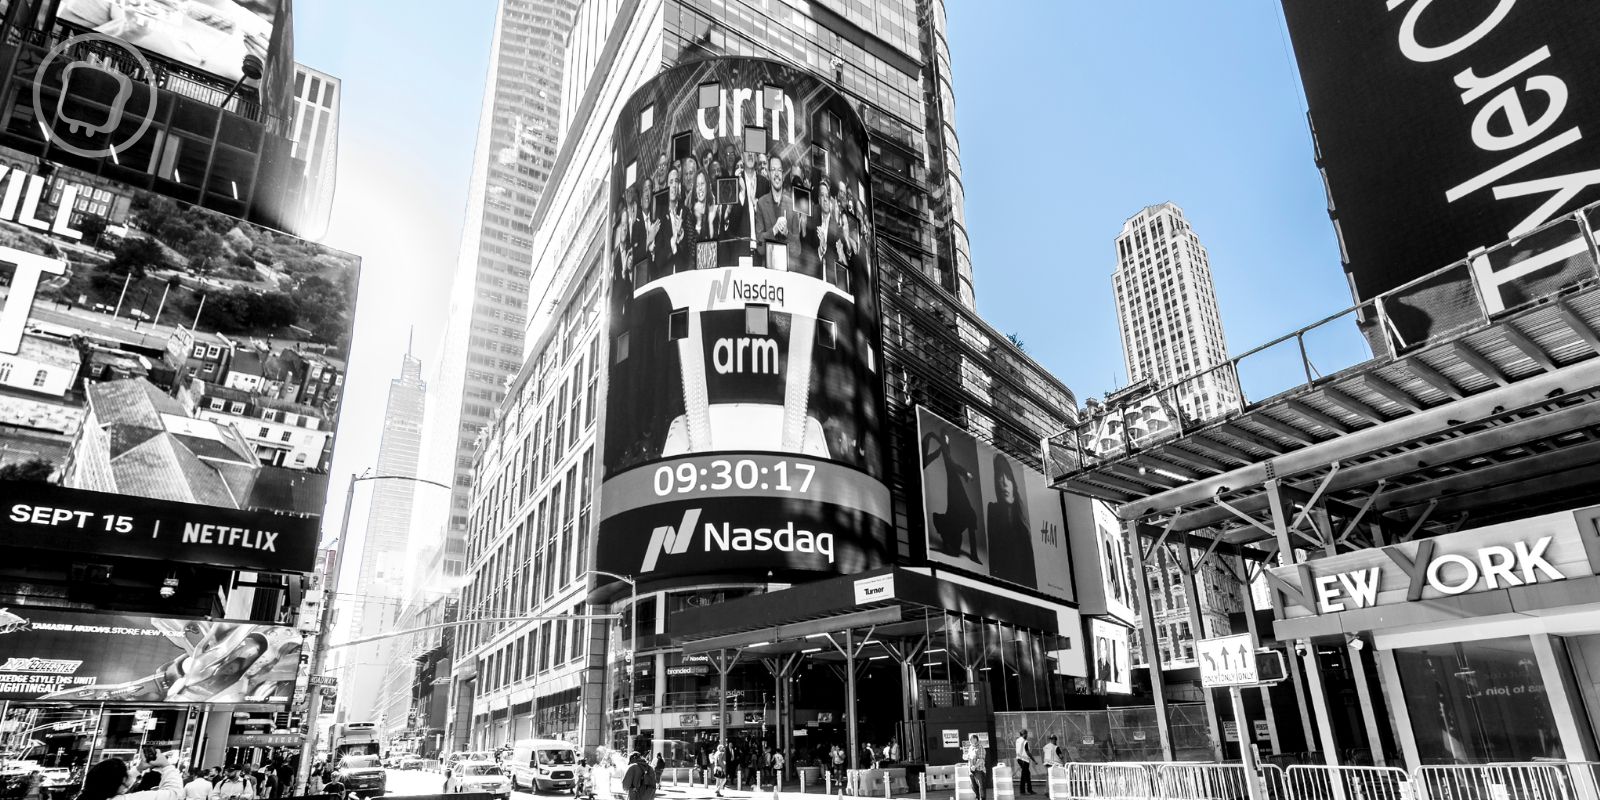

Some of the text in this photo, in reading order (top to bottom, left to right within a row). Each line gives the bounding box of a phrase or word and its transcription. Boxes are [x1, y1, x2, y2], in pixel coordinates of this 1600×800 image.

[697, 88, 795, 144] arm
[1446, 45, 1600, 316] Tyler
[0, 164, 83, 239] ILL
[733, 280, 784, 307] Nasdaq
[713, 337, 779, 374] arm
[654, 460, 816, 496] 09:30:17
[9, 503, 279, 552] SEPT 15 NETFLIX
[705, 522, 834, 563] Nasdaq
[864, 587, 884, 595] Turner
[1266, 564, 1381, 620] NEW
[1382, 536, 1567, 602] YORK
[0, 683, 65, 692] IGHTINGALE
[29, 676, 56, 684] STYLE
